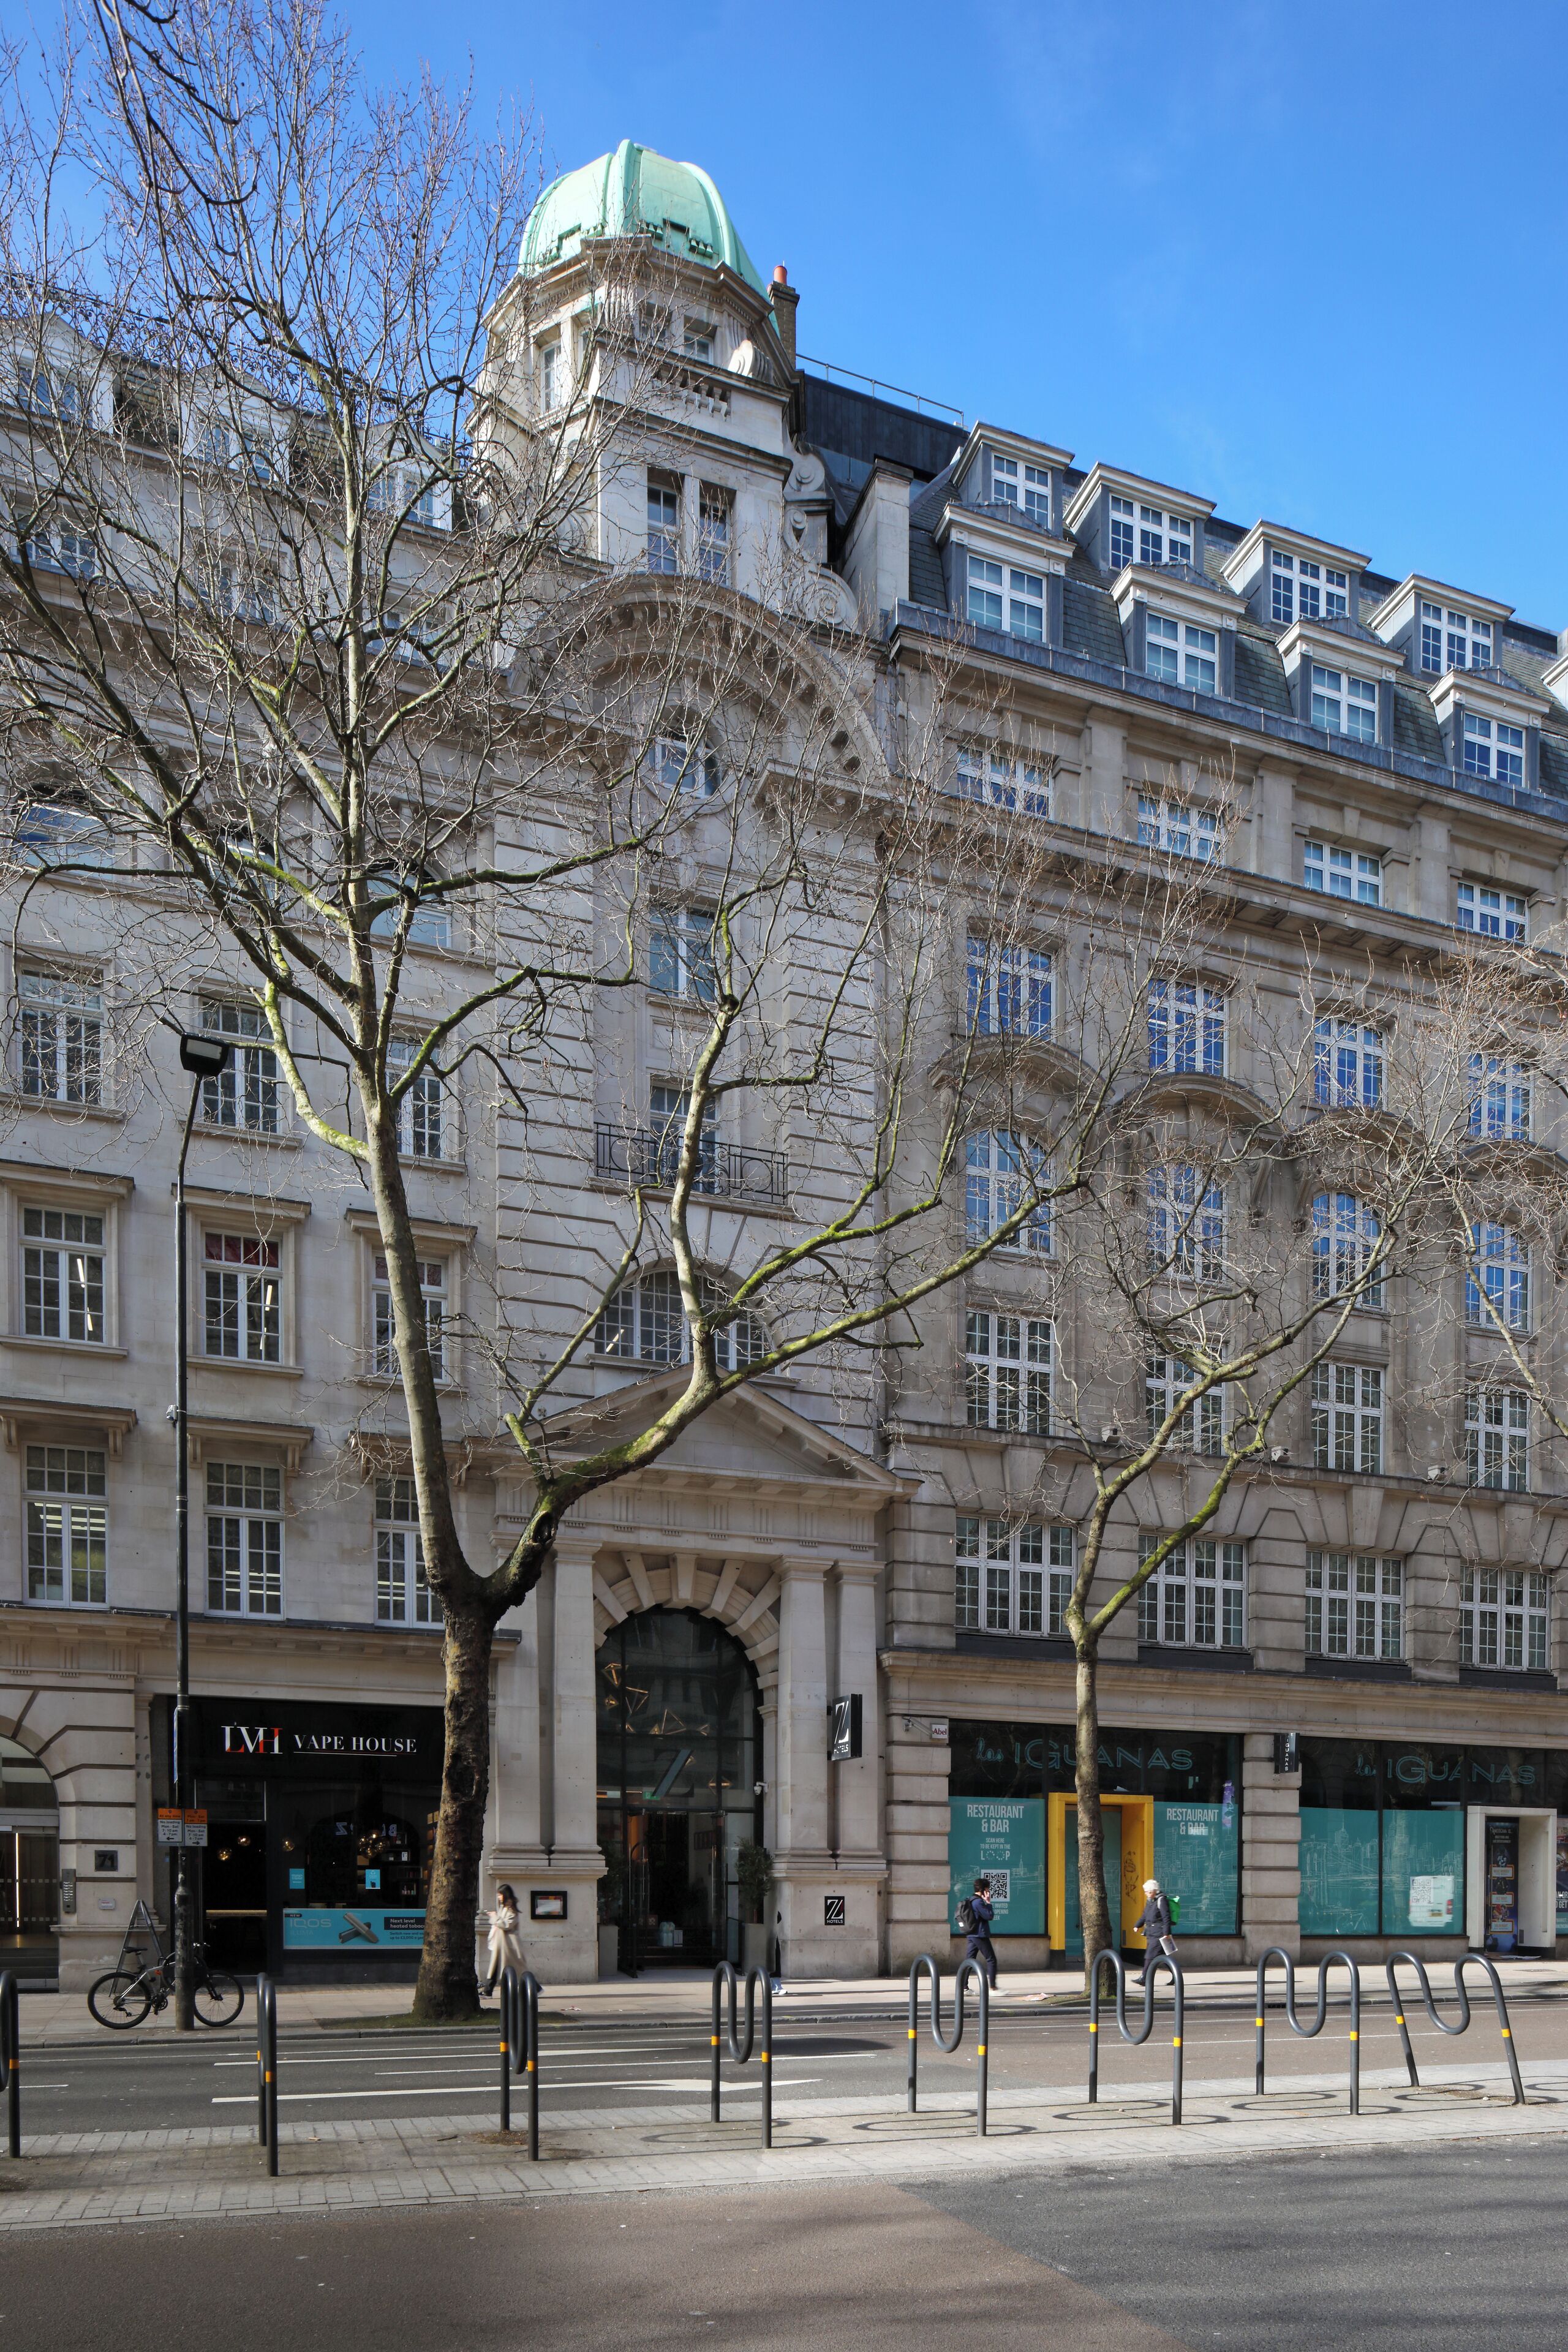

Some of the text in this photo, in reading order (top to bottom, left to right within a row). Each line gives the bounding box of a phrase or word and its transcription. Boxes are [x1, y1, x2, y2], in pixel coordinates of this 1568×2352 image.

[834, 1701, 849, 1744] Z
[293, 1735, 344, 1750] VAPE
[352, 1736, 417, 1753] HOUSE
[1014, 1739, 1193, 1770] IGUANAS
[1387, 1755, 1536, 1784] IGUANAS
[967, 1804, 1025, 1819] RESTAURANT
[1166, 1807, 1219, 1822] RESTAURANT
[981, 1819, 1009, 1833] & BAR
[1180, 1822, 1205, 1836] & BAR
[97, 1853, 115, 1868] 71
[826, 1899, 843, 1919] Z
[290, 1918, 332, 1928] IQOS
